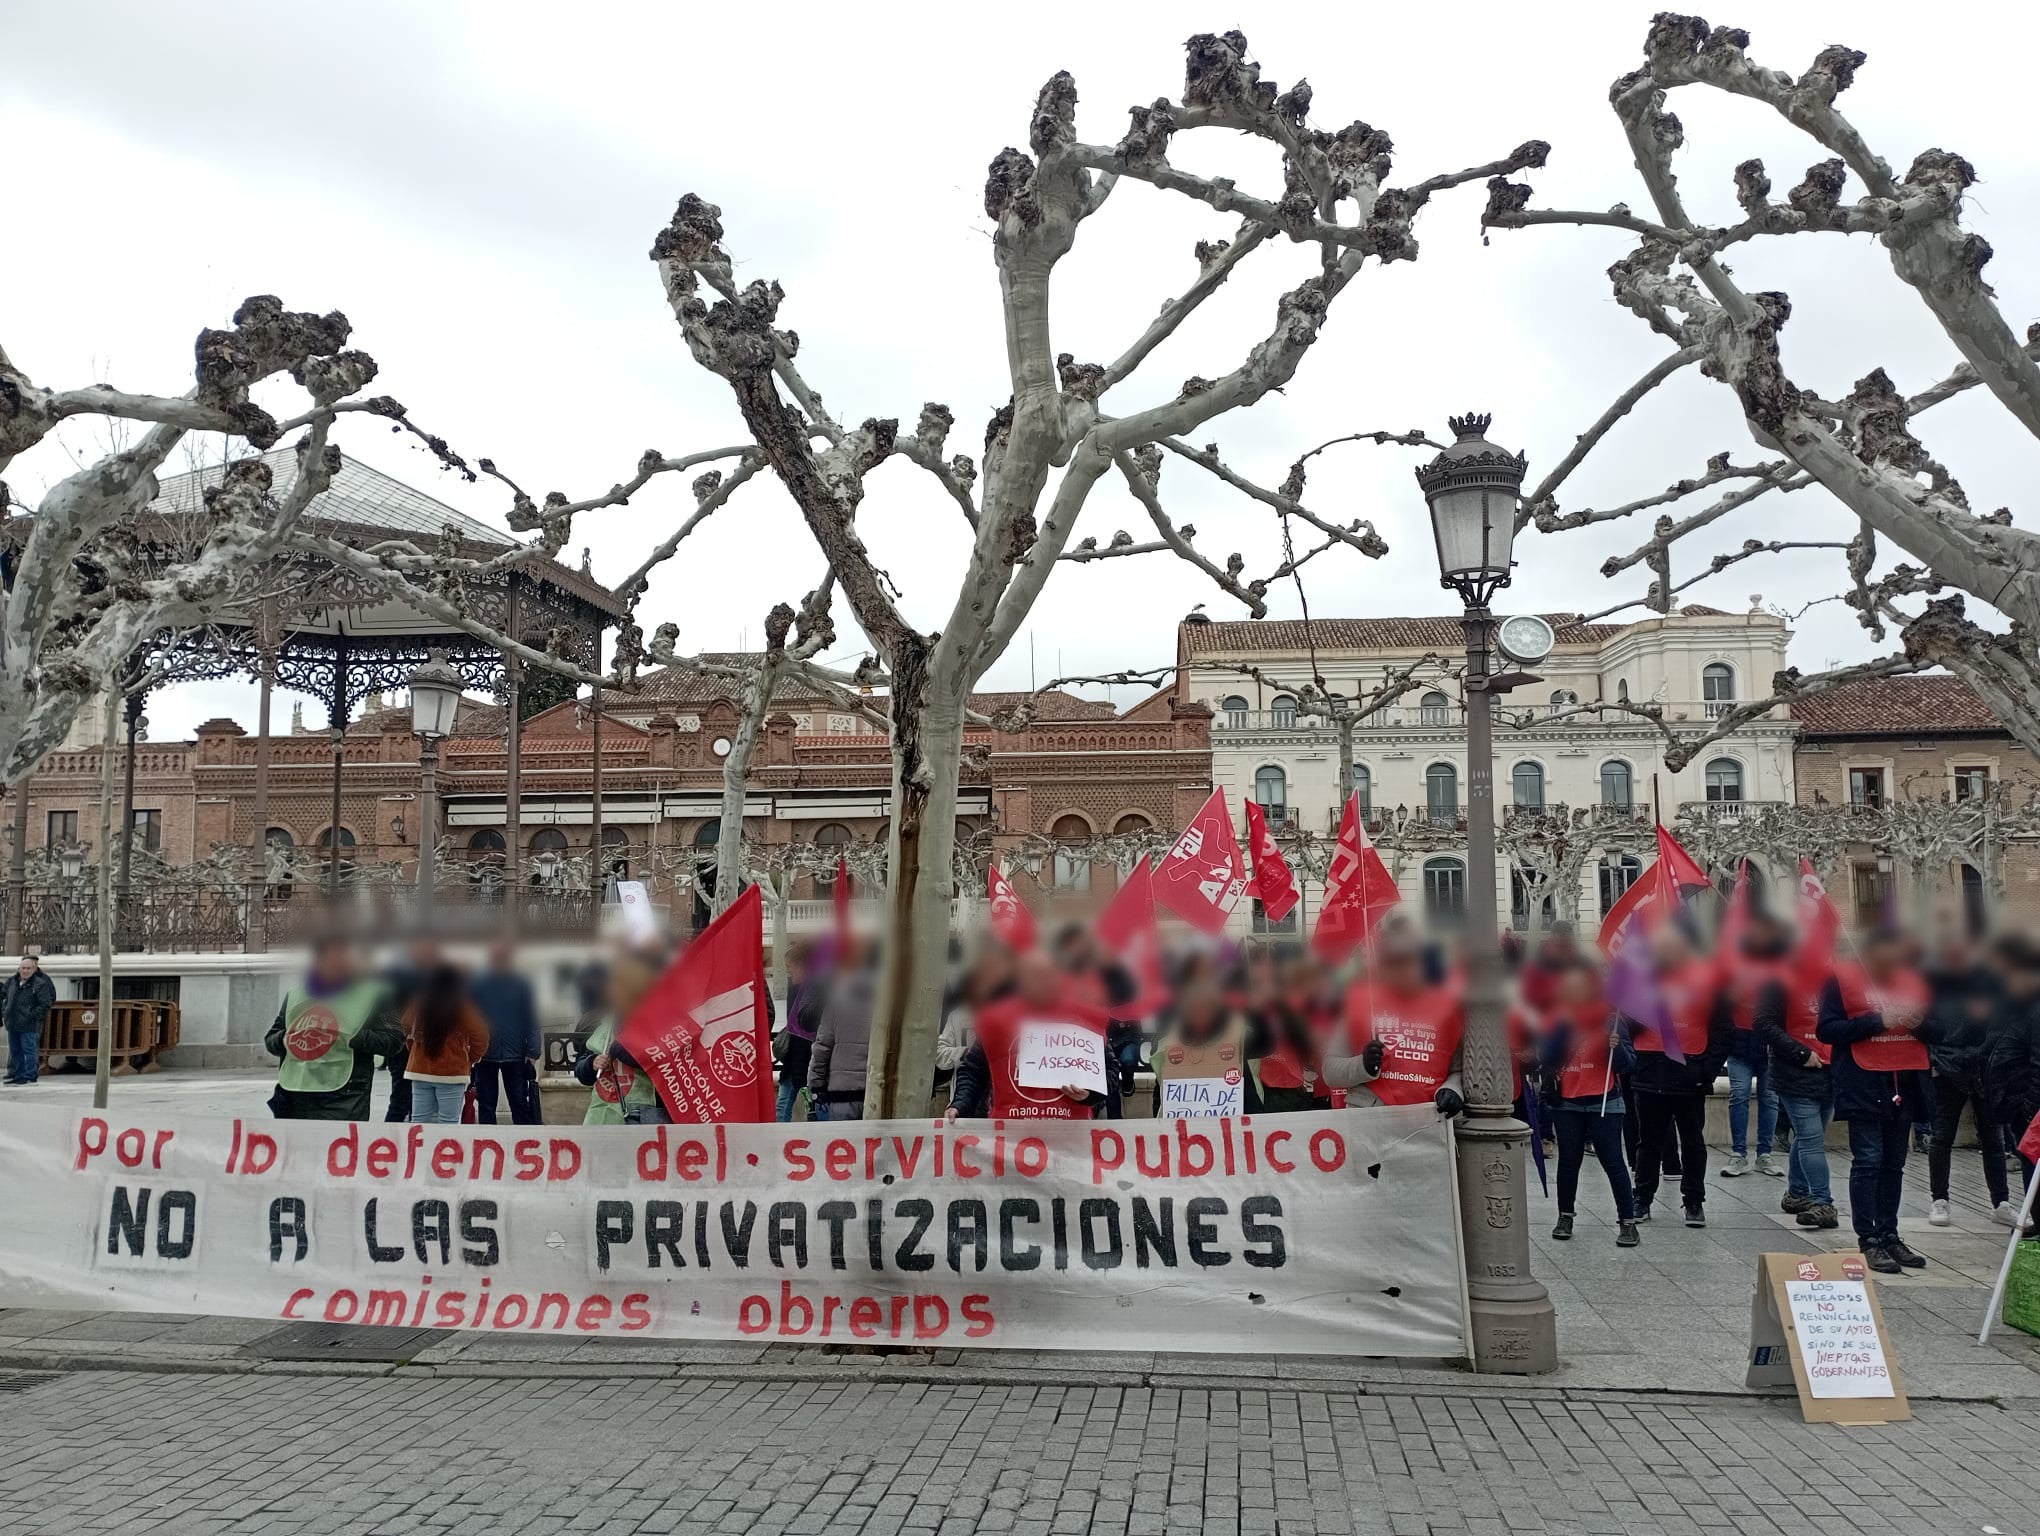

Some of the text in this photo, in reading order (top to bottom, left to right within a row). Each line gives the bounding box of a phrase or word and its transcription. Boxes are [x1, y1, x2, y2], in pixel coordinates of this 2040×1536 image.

[295, 1015, 331, 1030] UGT
[1417, 1030, 1436, 1040] tuyo
[1395, 1050, 1429, 1062] CCOO
[660, 1033, 696, 1096] SERVICIOS
[672, 1025, 726, 1117] FEDERACIÓN DE
[1038, 1057, 1100, 1075] ASESORES
[644, 1045, 689, 1113] DE MADRID
[1166, 1083, 1240, 1106] FALTA DE
[1008, 1107, 1039, 1117] mano
[74, 1117, 174, 1170] por
[326, 1123, 581, 1181] defensa
[637, 1125, 726, 1183] del
[784, 1119, 1047, 1183] servicio
[1091, 1117, 1347, 1184] publico
[108, 1186, 1287, 1274] NO A LAS PRIVATIZACIONES
[1798, 1262, 1815, 1274] UGT
[1810, 1282, 1834, 1291] LOS
[281, 1275, 995, 1340] comisiones obreras
[1817, 1303, 1835, 1312] NO
[1808, 1325, 1824, 1334] DE
[1842, 1341, 1854, 1349] DE
[1811, 1366, 1887, 1378] GOBERNANTES
